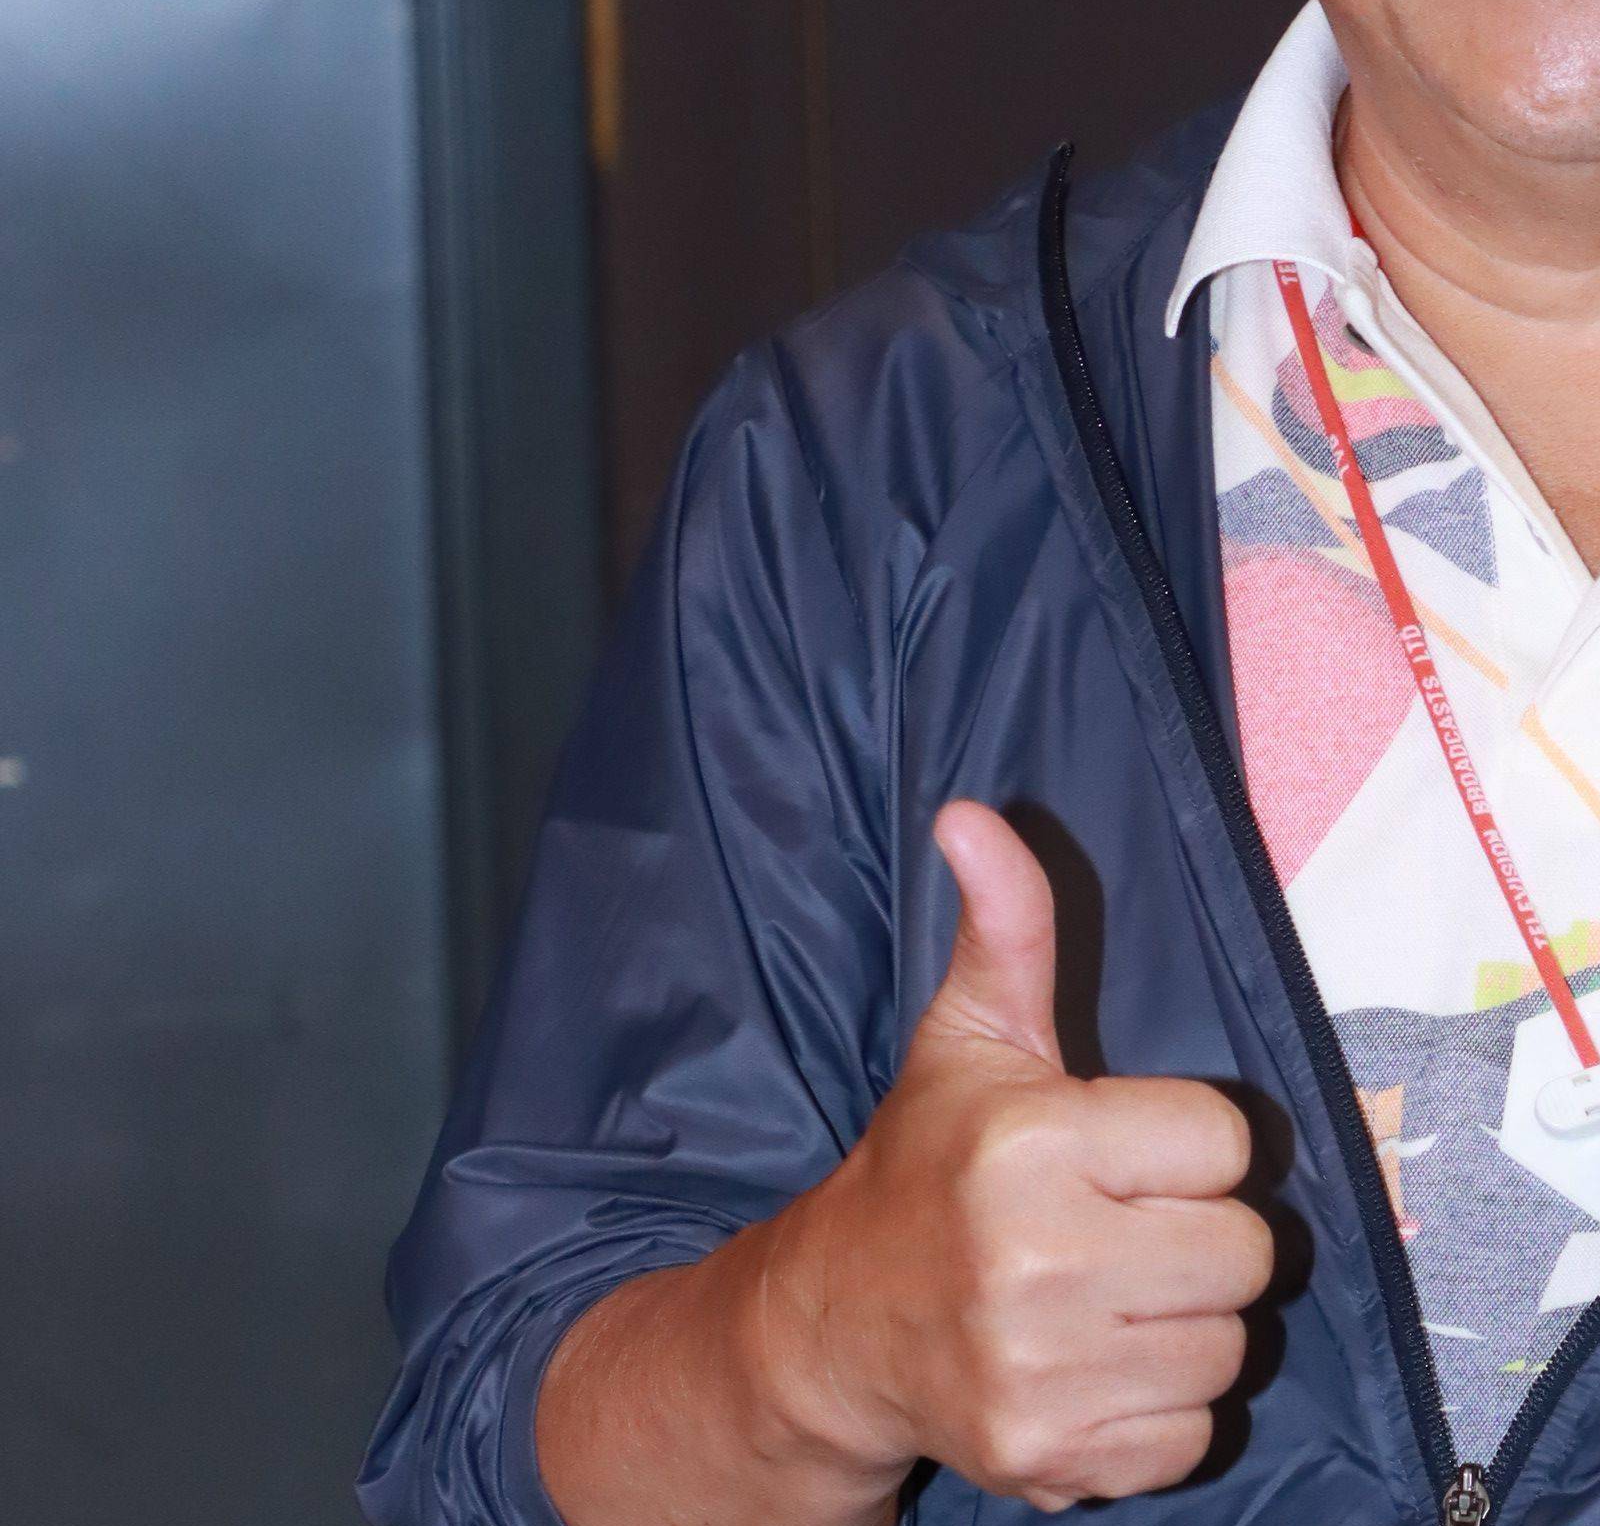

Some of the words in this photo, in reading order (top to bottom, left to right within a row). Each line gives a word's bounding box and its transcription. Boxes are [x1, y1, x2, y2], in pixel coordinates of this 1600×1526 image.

[1401, 625, 1431, 664] LTD
[1422, 675, 1490, 815] BROADCASTS
[1483, 828, 1548, 950] TELEVISION
